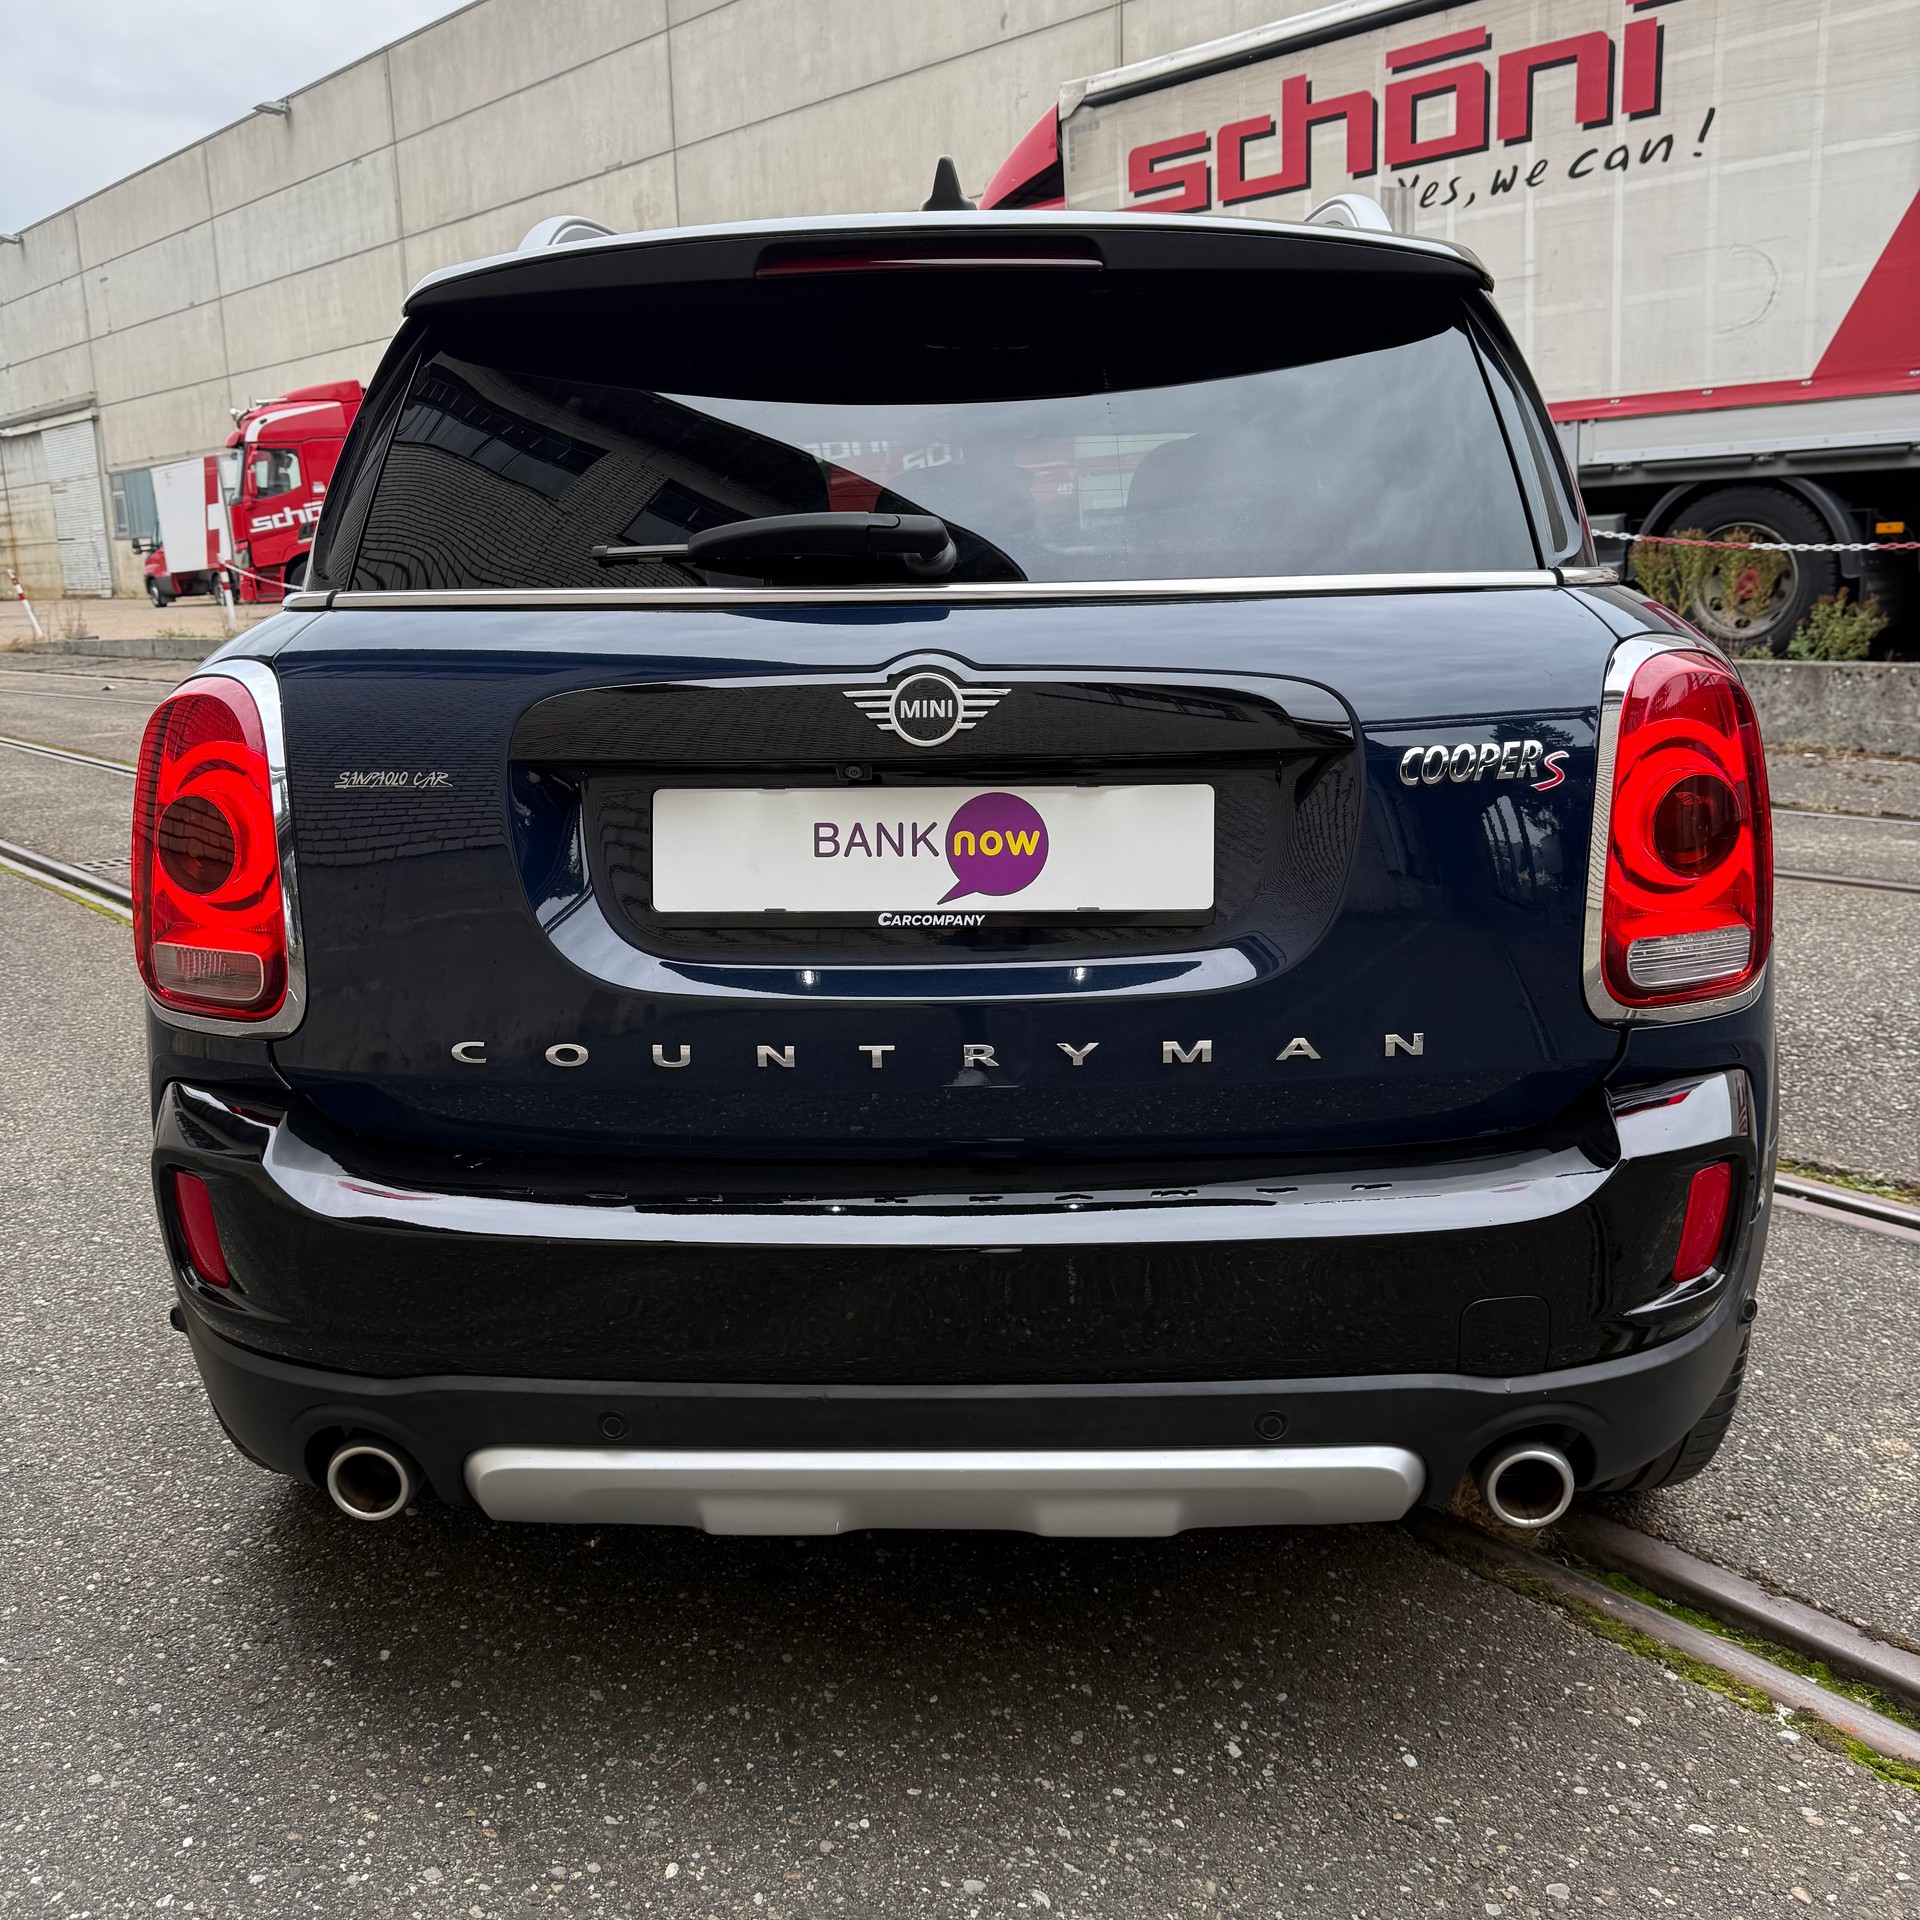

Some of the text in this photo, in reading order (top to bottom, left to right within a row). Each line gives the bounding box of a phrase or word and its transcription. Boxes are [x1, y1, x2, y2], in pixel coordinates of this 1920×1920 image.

[1490, 159, 1548, 196] we
[900, 699, 953, 719] MINI
[334, 771, 454, 789] SANPAOLO CAR
[1400, 739, 1570, 792] COOPER S
[813, 822, 1040, 858] BANK now
[450, 1032, 1425, 1069] COUNTRYMAN
